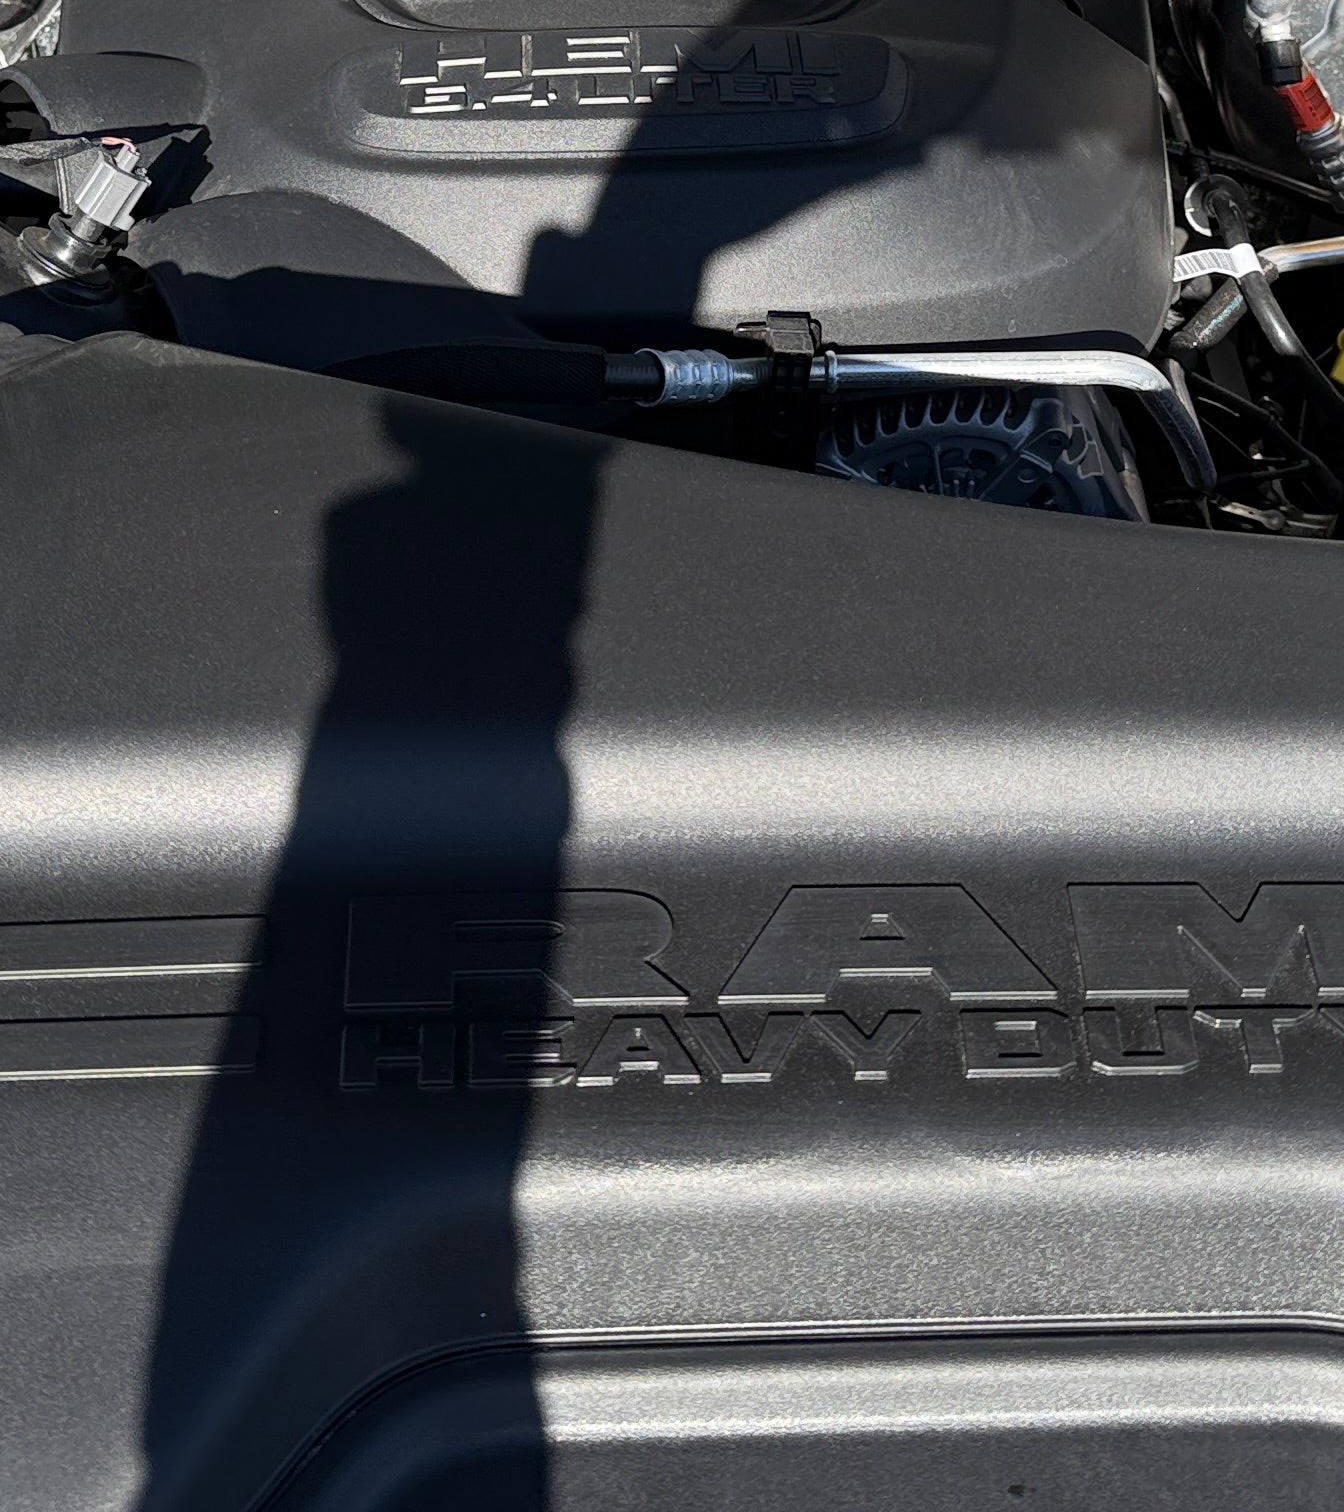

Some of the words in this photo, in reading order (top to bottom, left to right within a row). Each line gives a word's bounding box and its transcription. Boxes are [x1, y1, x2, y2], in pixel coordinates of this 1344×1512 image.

[399, 31, 842, 86] HEMI
[575, 73, 839, 106] LITER
[339, 1008, 923, 1088] HEAVY
